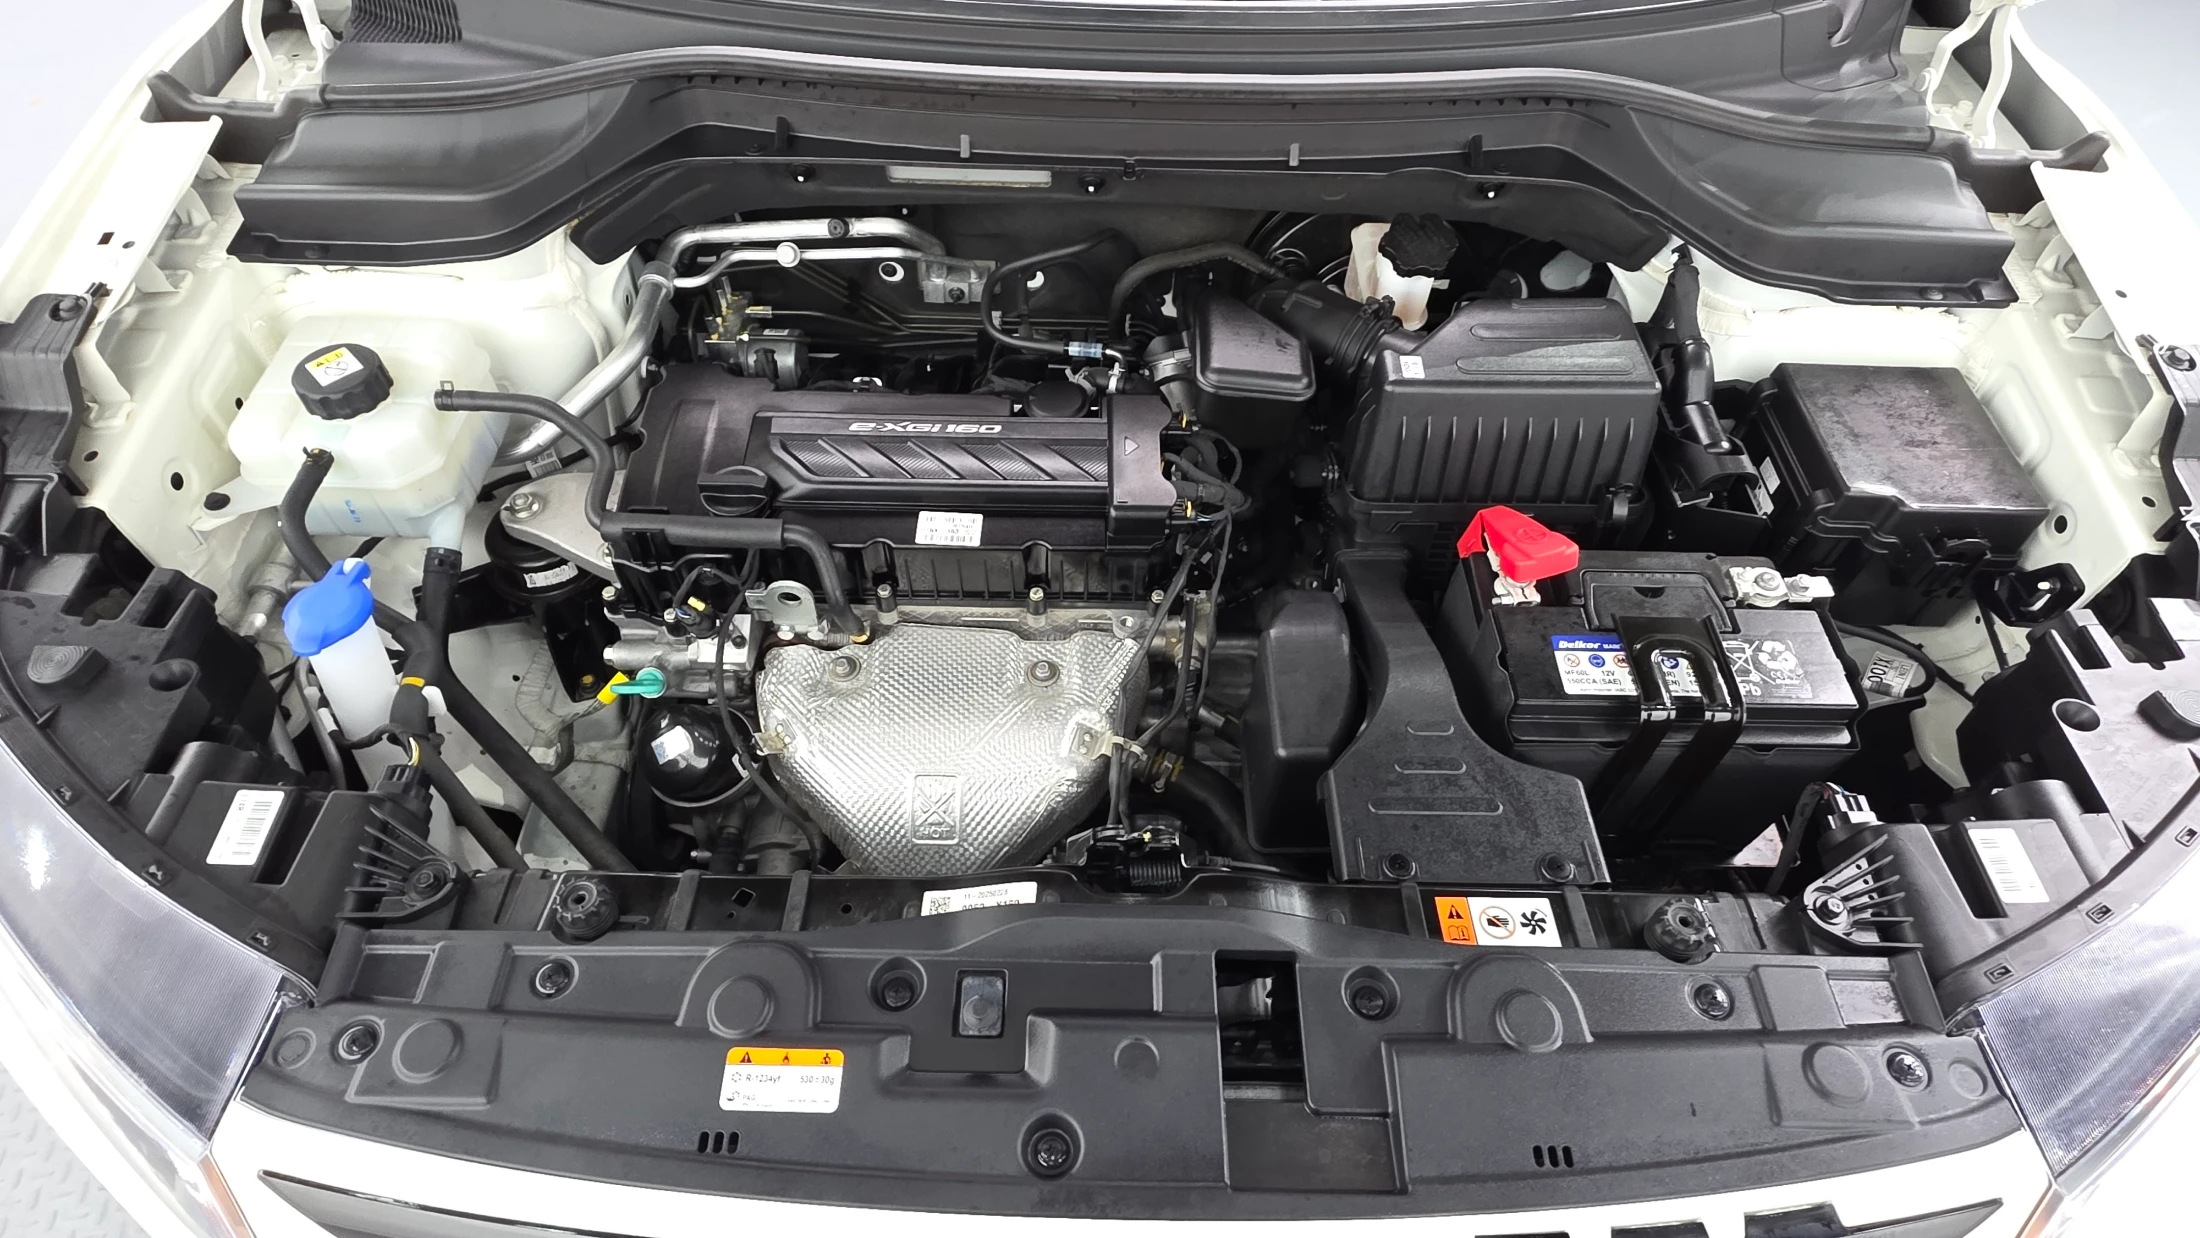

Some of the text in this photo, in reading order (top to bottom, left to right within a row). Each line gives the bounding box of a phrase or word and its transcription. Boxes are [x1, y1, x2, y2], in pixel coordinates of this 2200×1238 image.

[945, 423, 1003, 434] 160
[1558, 640, 1601, 649] Delkor
[1867, 655, 1895, 683] X100
[1738, 683, 1761, 696] Pb
[745, 1073, 781, 1084] R-1234yf
[800, 1075, 814, 1084] 530
[821, 1075, 835, 1086] 30g
